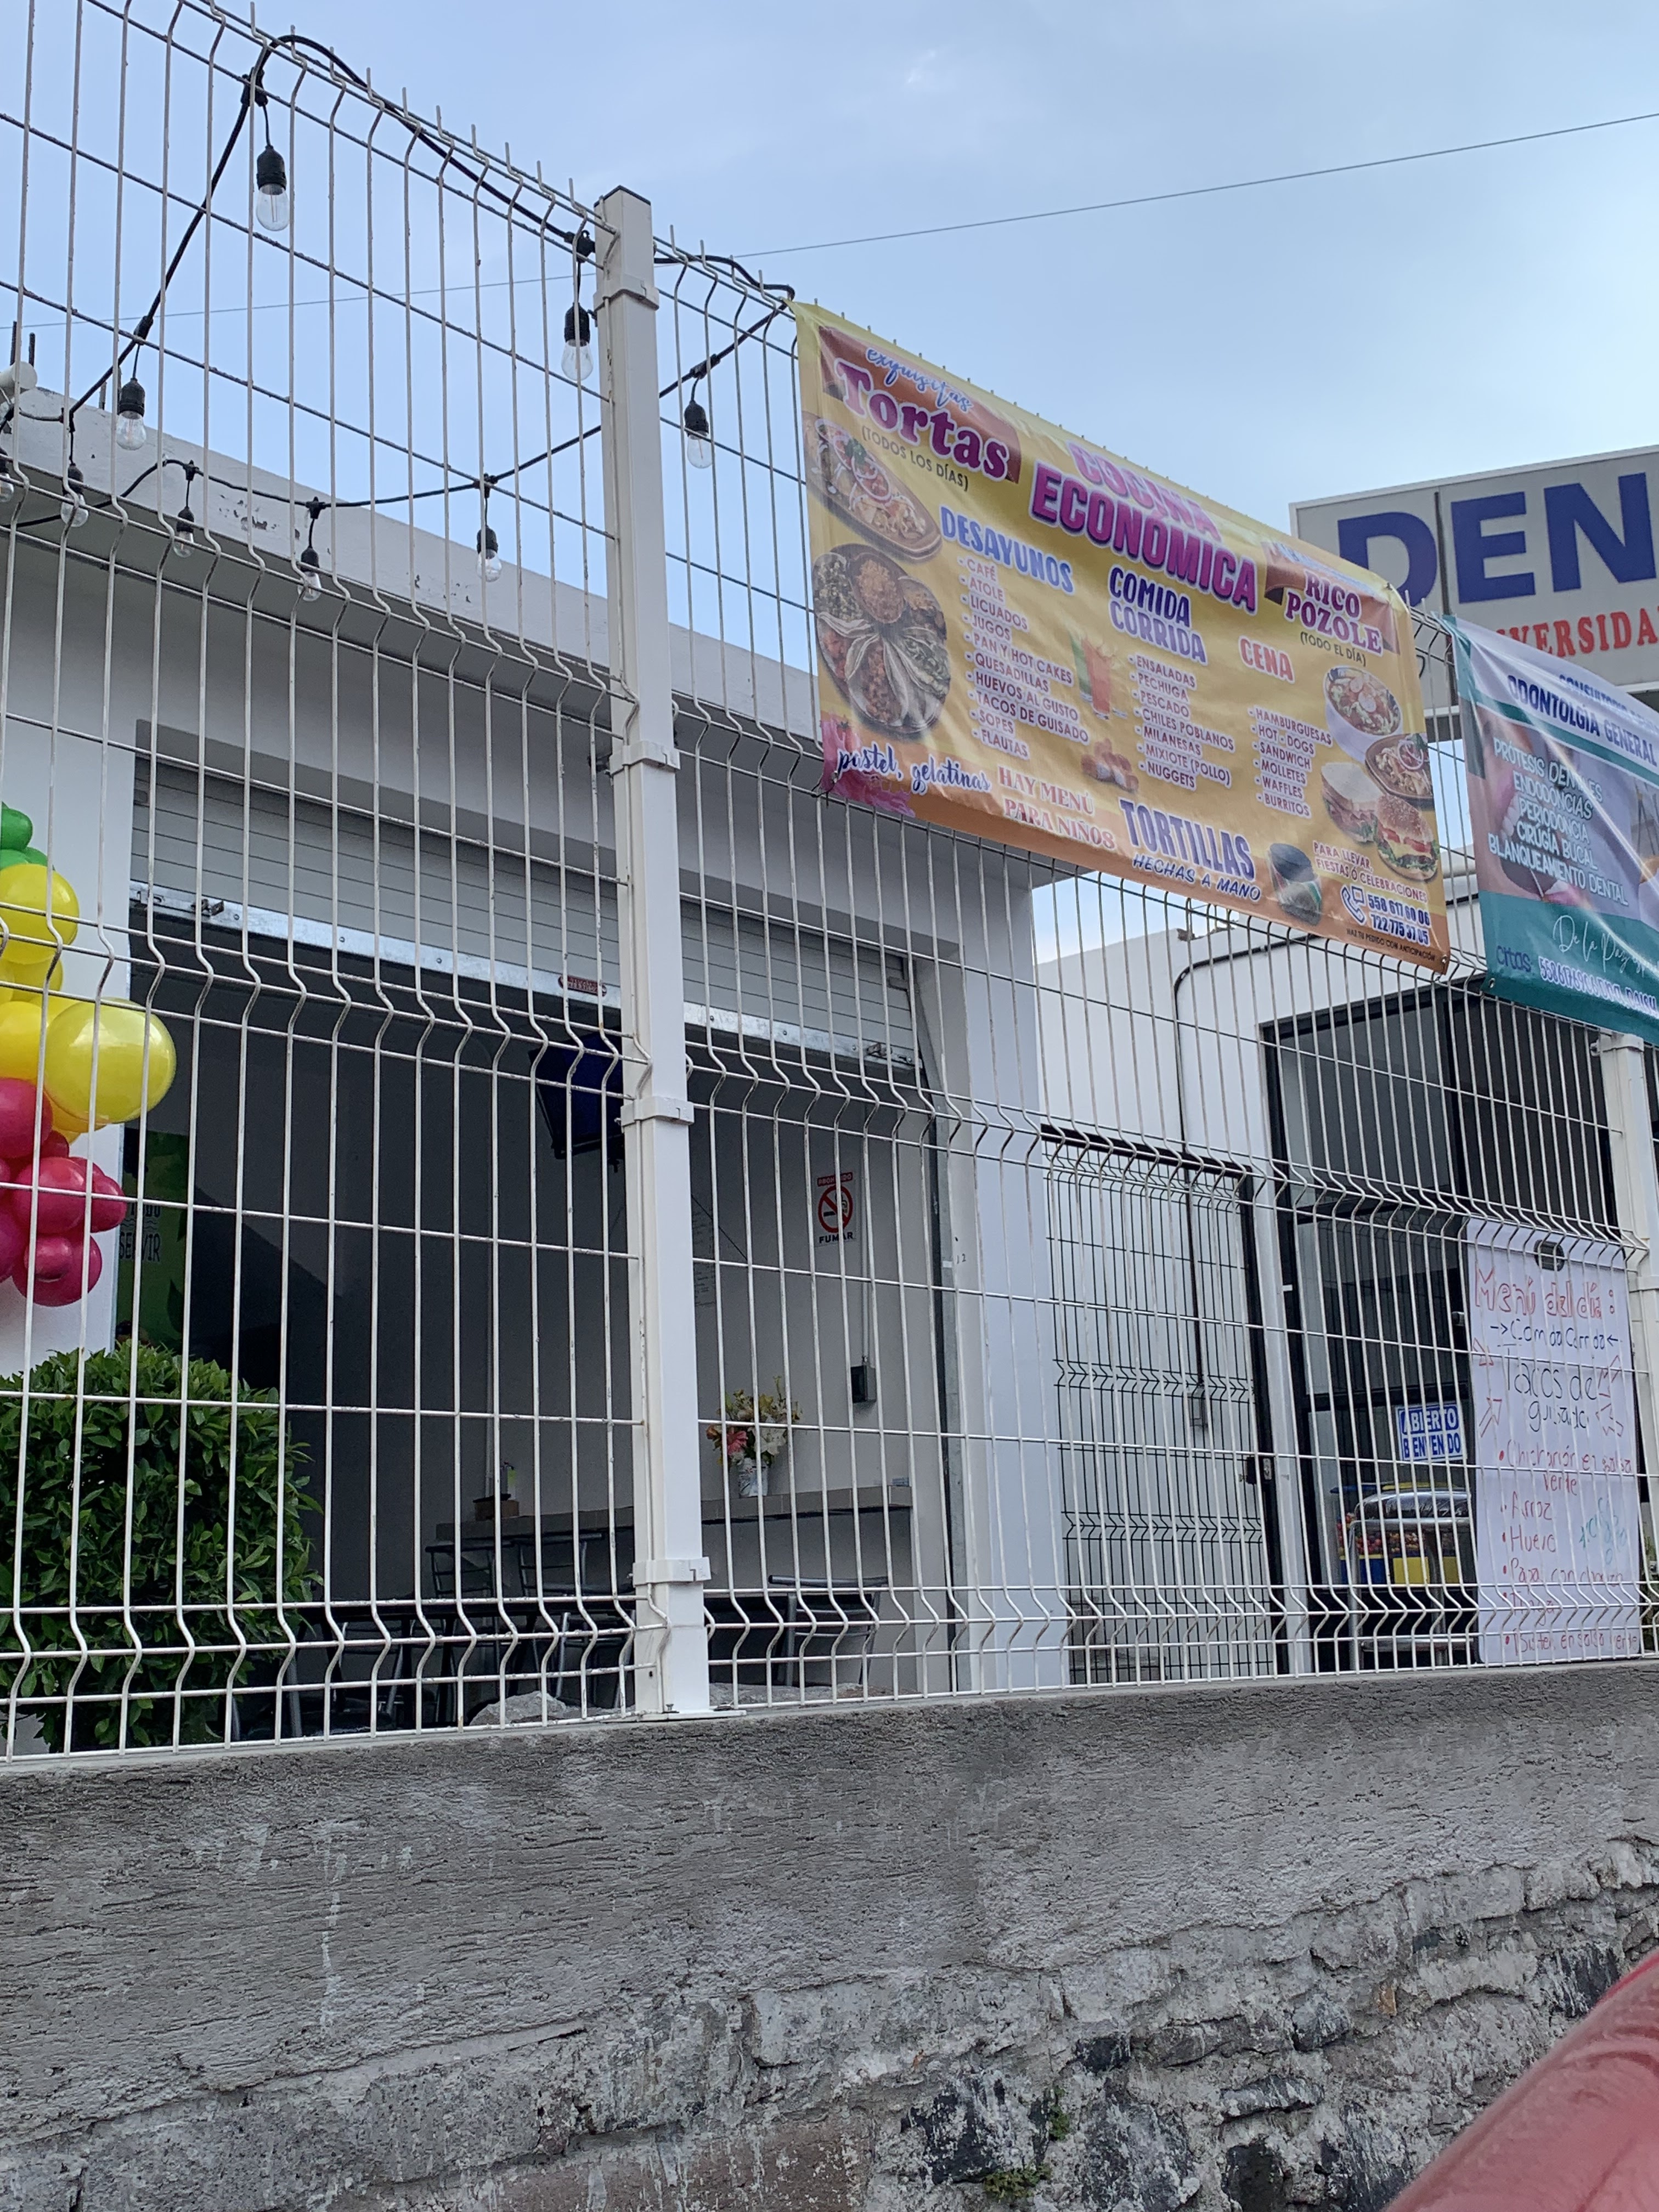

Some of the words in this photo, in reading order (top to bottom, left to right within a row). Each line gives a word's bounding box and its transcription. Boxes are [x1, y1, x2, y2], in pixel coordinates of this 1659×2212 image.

[867, 348, 973, 411] exquisitas
[836, 360, 1009, 481] Tortas
[861, 425, 906, 458] (TODOS
[910, 451, 932, 472] LOS
[936, 461, 969, 492] DÍAS)
[1068, 442, 1222, 542] COCINA
[940, 506, 1074, 594] DESAYUNOS
[967, 558, 996, 582] CAFÉ
[969, 577, 1003, 602] ATOLE
[1109, 567, 1191, 628] COMIDA
[1306, 572, 1361, 618] RICO
[970, 595, 1028, 630] LICUADOS
[972, 614, 1011, 641] JUGOS
[1285, 592, 1383, 654] POZOLE
[1109, 601, 1207, 664] CORRIDA
[1300, 631, 1330, 651] (TODO
[1334, 645, 1344, 658] EL
[974, 633, 997, 653] PAN
[1000, 644, 1008, 657] Y
[1011, 650, 1034, 668] HOT
[1036, 659, 1072, 684] CAKES
[975, 652, 1049, 692] QUESADILLAS
[1136, 654, 1195, 688] ENSALADAS
[1240, 637, 1294, 681] CENA
[976, 671, 1022, 699] HUEVOS
[1026, 691, 1040, 707] AL
[1043, 701, 1079, 721] GUSTO
[1138, 673, 1188, 702] PECHUGA
[1140, 691, 1189, 718] PESCADO
[977, 691, 1016, 716] TACOS
[1020, 706, 1035, 723] DE
[1037, 715, 1089, 742] GUISADO
[979, 710, 1014, 734] SOPES
[1142, 708, 1177, 730] CHILES
[1180, 721, 1234, 751] POBLANOS
[1255, 708, 1331, 746] HAMBURGUESAS
[981, 729, 1028, 757] FLAUTAS
[1144, 725, 1201, 756] MILANESAS
[1258, 724, 1278, 742] HOT
[1287, 735, 1314, 755] DOGS
[1260, 742, 1311, 770] SANDWICH
[1604, 719, 1658, 767] GENERAL
[910, 758, 991, 795] gelatinas
[1146, 743, 1188, 768] MIXIOTE
[1190, 759, 1231, 786] (POLLO)
[1147, 761, 1195, 788] NUGGETS
[1261, 759, 1306, 785] MOLLETES
[1493, 737, 1545, 778] PRÓTESIS
[1549, 761, 1602, 803] DENES
[998, 766, 1036, 795] HAY
[1040, 782, 1094, 814] MENÚ
[1262, 775, 1303, 799] WAFFLES
[1264, 793, 1310, 816] BURRITOS
[1005, 798, 1053, 831] PARA
[1057, 816, 1115, 849] NIÑOS
[1120, 799, 1255, 881] TORTILLAS
[1313, 842, 1339, 857] PARA
[1561, 837, 1598, 871] BUCAL
[1133, 853, 1195, 883] HECHAS
[1201, 873, 1211, 887] A
[1216, 878, 1261, 901] MANO
[1317, 859, 1349, 878] FIESTAS
[1359, 872, 1427, 902] CELEBRACIONES
[1589, 873, 1629, 906] DENTAL
[1367, 894, 1387, 912] 558
[818, 1173, 852, 1186] PROHIDO
[119, 1231, 161, 1262] SEVIR
[1475, 1262, 1536, 1316] Menú
[1545, 1280, 1573, 1317] del
[1510, 1318, 1562, 1346] Comda
[1565, 1327, 1606, 1350] Crrda
[1497, 1342, 1562, 1400] Tacos
[1403, 1432, 1461, 1459] BENENDO
